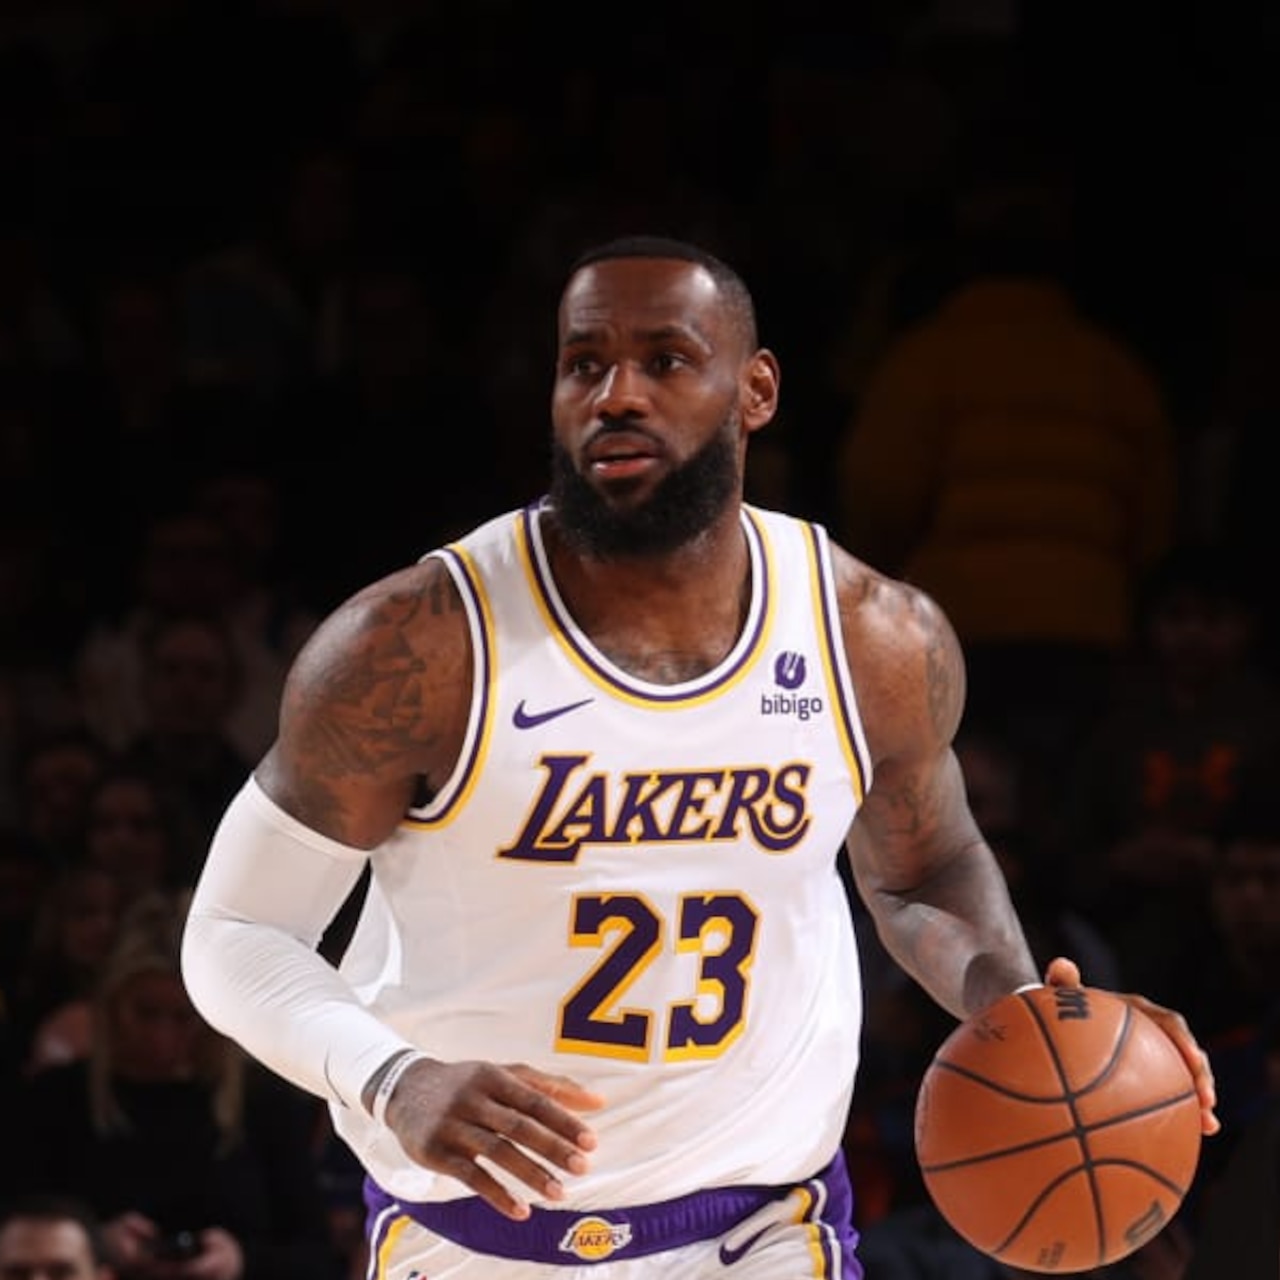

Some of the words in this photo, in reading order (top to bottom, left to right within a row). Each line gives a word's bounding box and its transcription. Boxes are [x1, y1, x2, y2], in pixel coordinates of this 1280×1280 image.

[761, 694, 822, 720] bibigo
[494, 751, 811, 865] LAKERS
[554, 890, 760, 1064] 23
